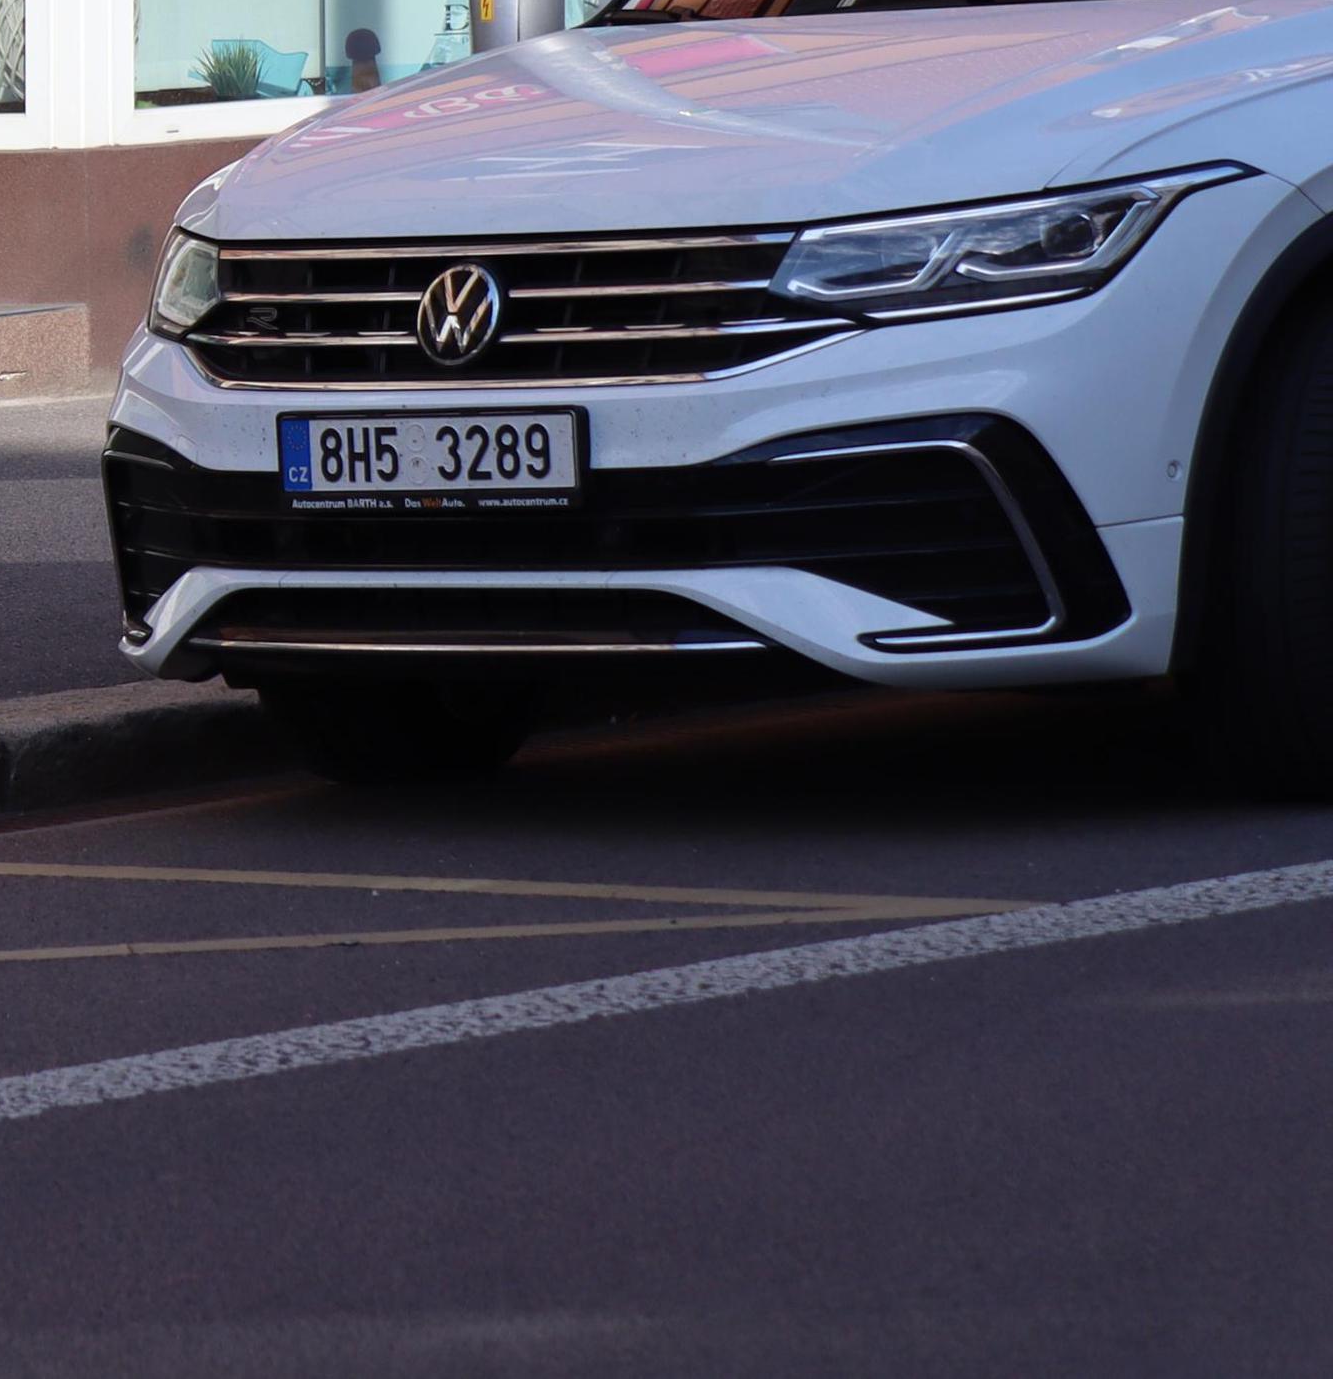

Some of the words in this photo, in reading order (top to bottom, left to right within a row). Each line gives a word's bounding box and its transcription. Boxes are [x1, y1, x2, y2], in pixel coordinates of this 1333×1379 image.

[320, 426, 399, 483] 8H5
[435, 423, 551, 482] 3289
[288, 466, 309, 483] CZ
